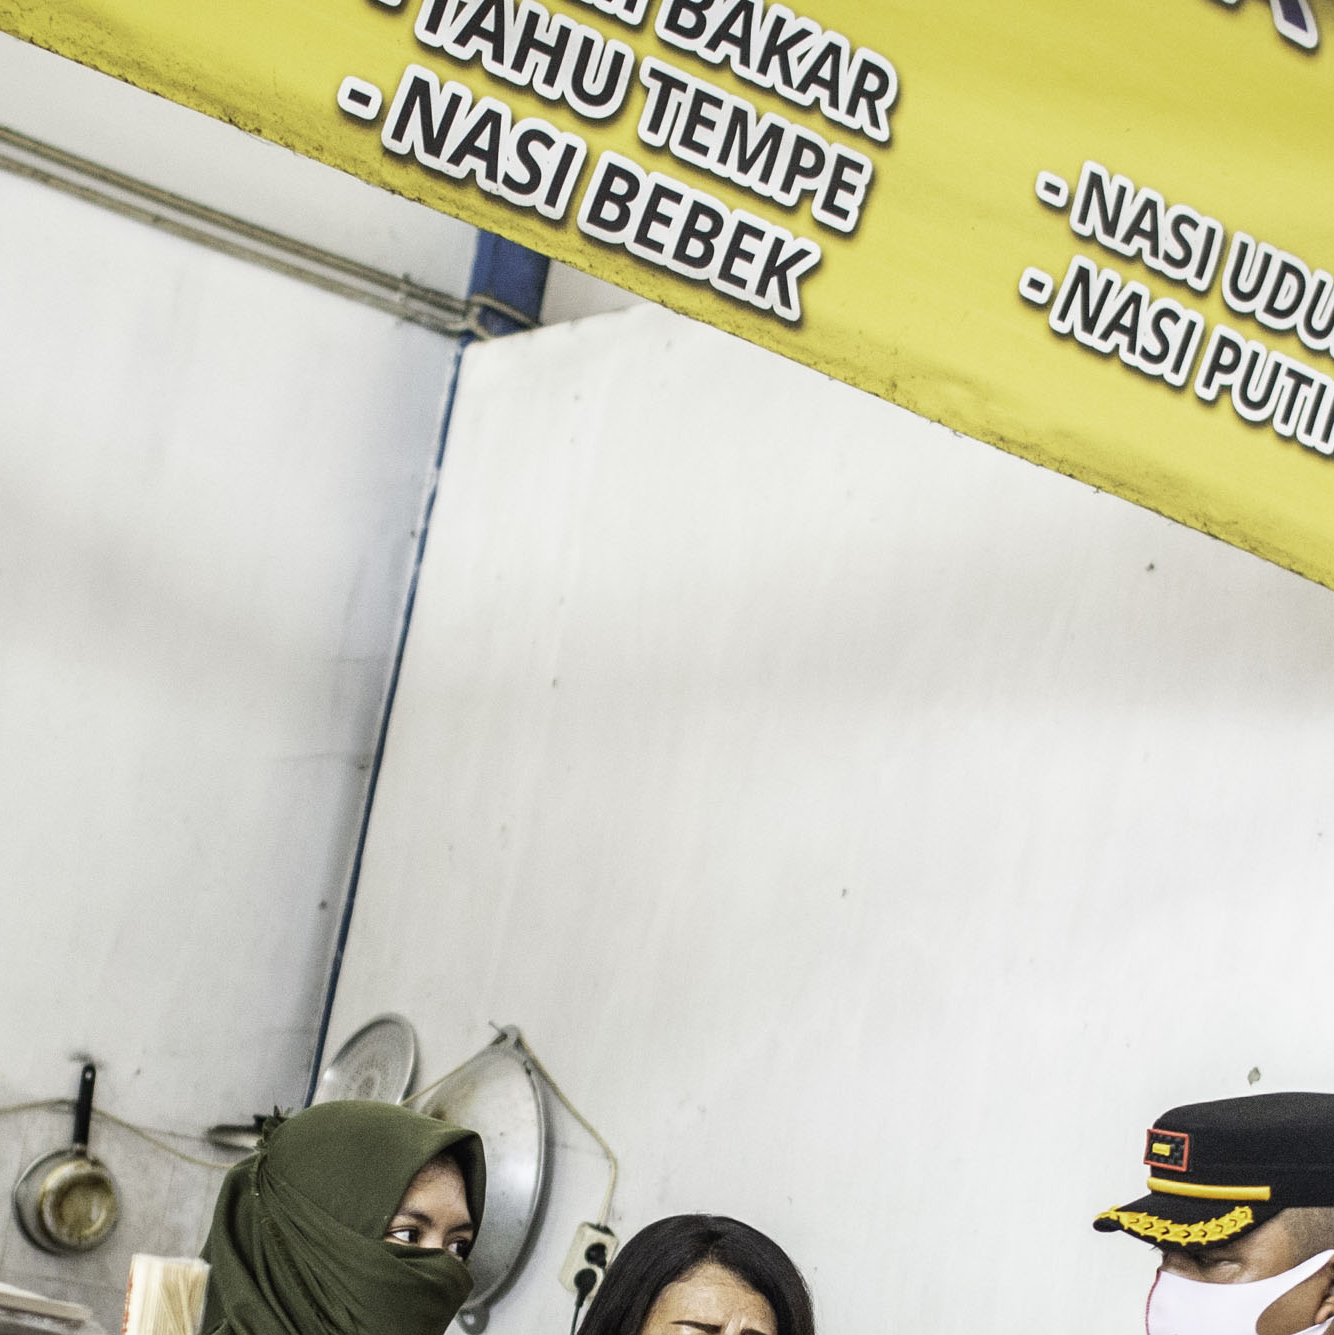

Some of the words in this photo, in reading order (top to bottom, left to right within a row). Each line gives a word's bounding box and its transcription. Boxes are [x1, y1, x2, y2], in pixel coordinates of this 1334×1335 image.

[663, 0, 893, 132] BAKAR
[387, 74, 580, 210] NASI
[585, 160, 815, 312] BEBEK
[642, 65, 867, 223] TEMPE
[1082, 172, 1221, 284] NASI
[1059, 265, 1198, 376] NASI
